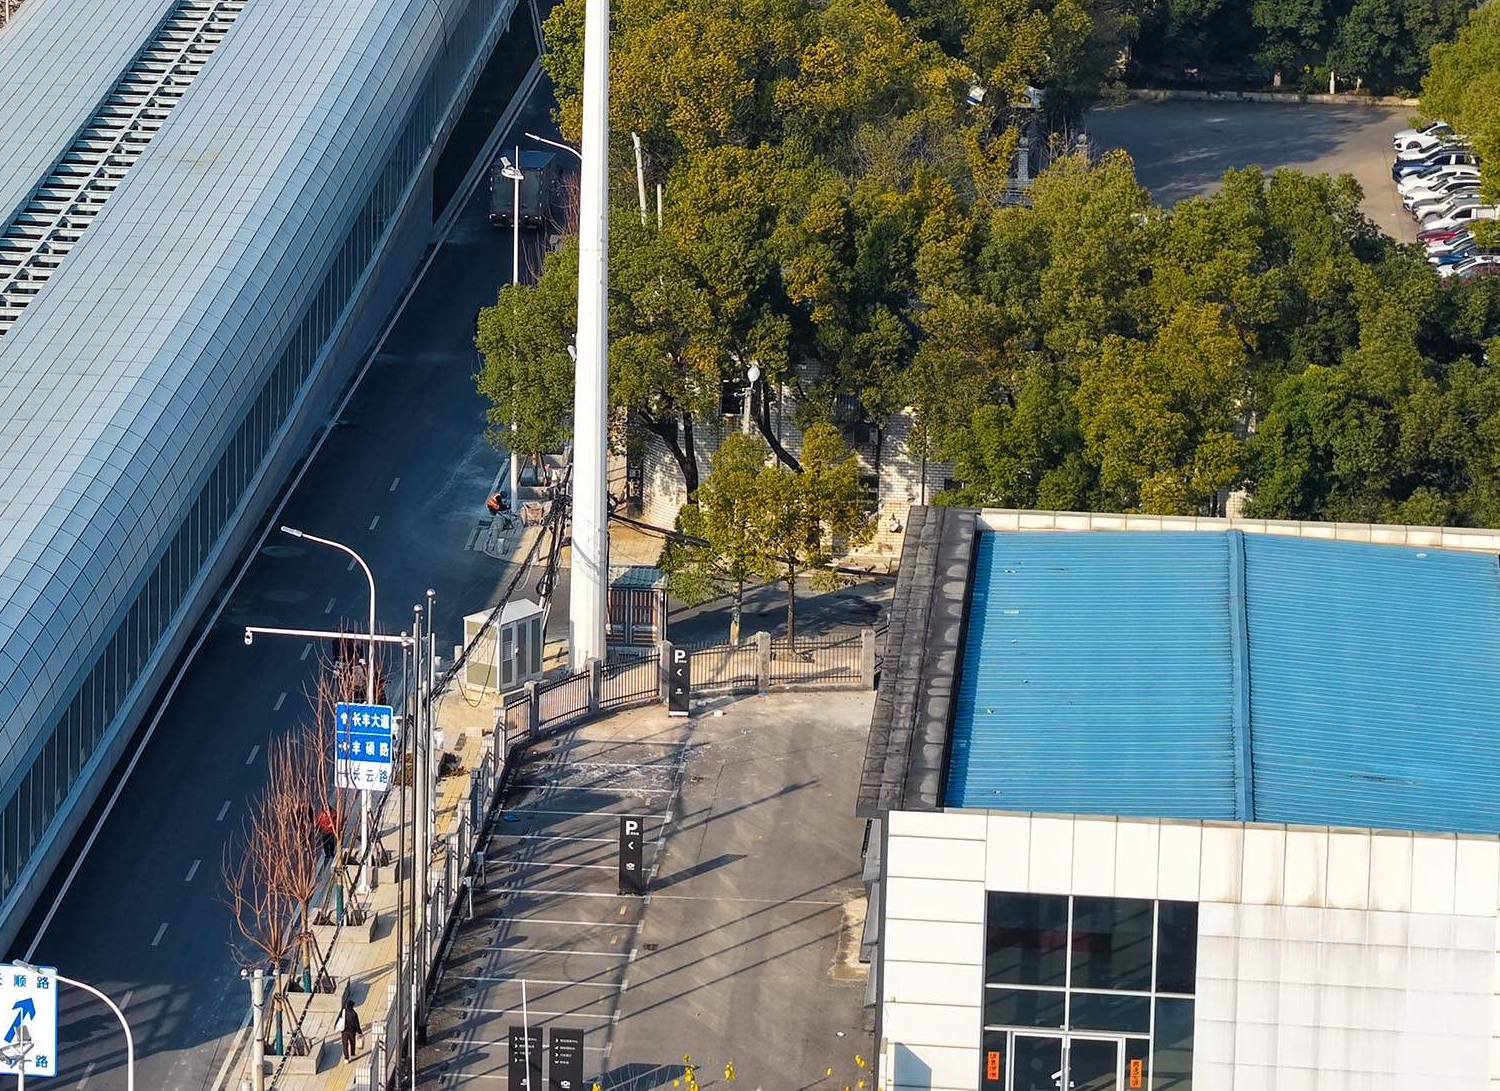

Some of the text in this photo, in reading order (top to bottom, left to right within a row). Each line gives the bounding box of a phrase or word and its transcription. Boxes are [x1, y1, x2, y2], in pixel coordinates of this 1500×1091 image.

[352, 712, 390, 729] 长丰大道
[625, 820, 638, 836] P
